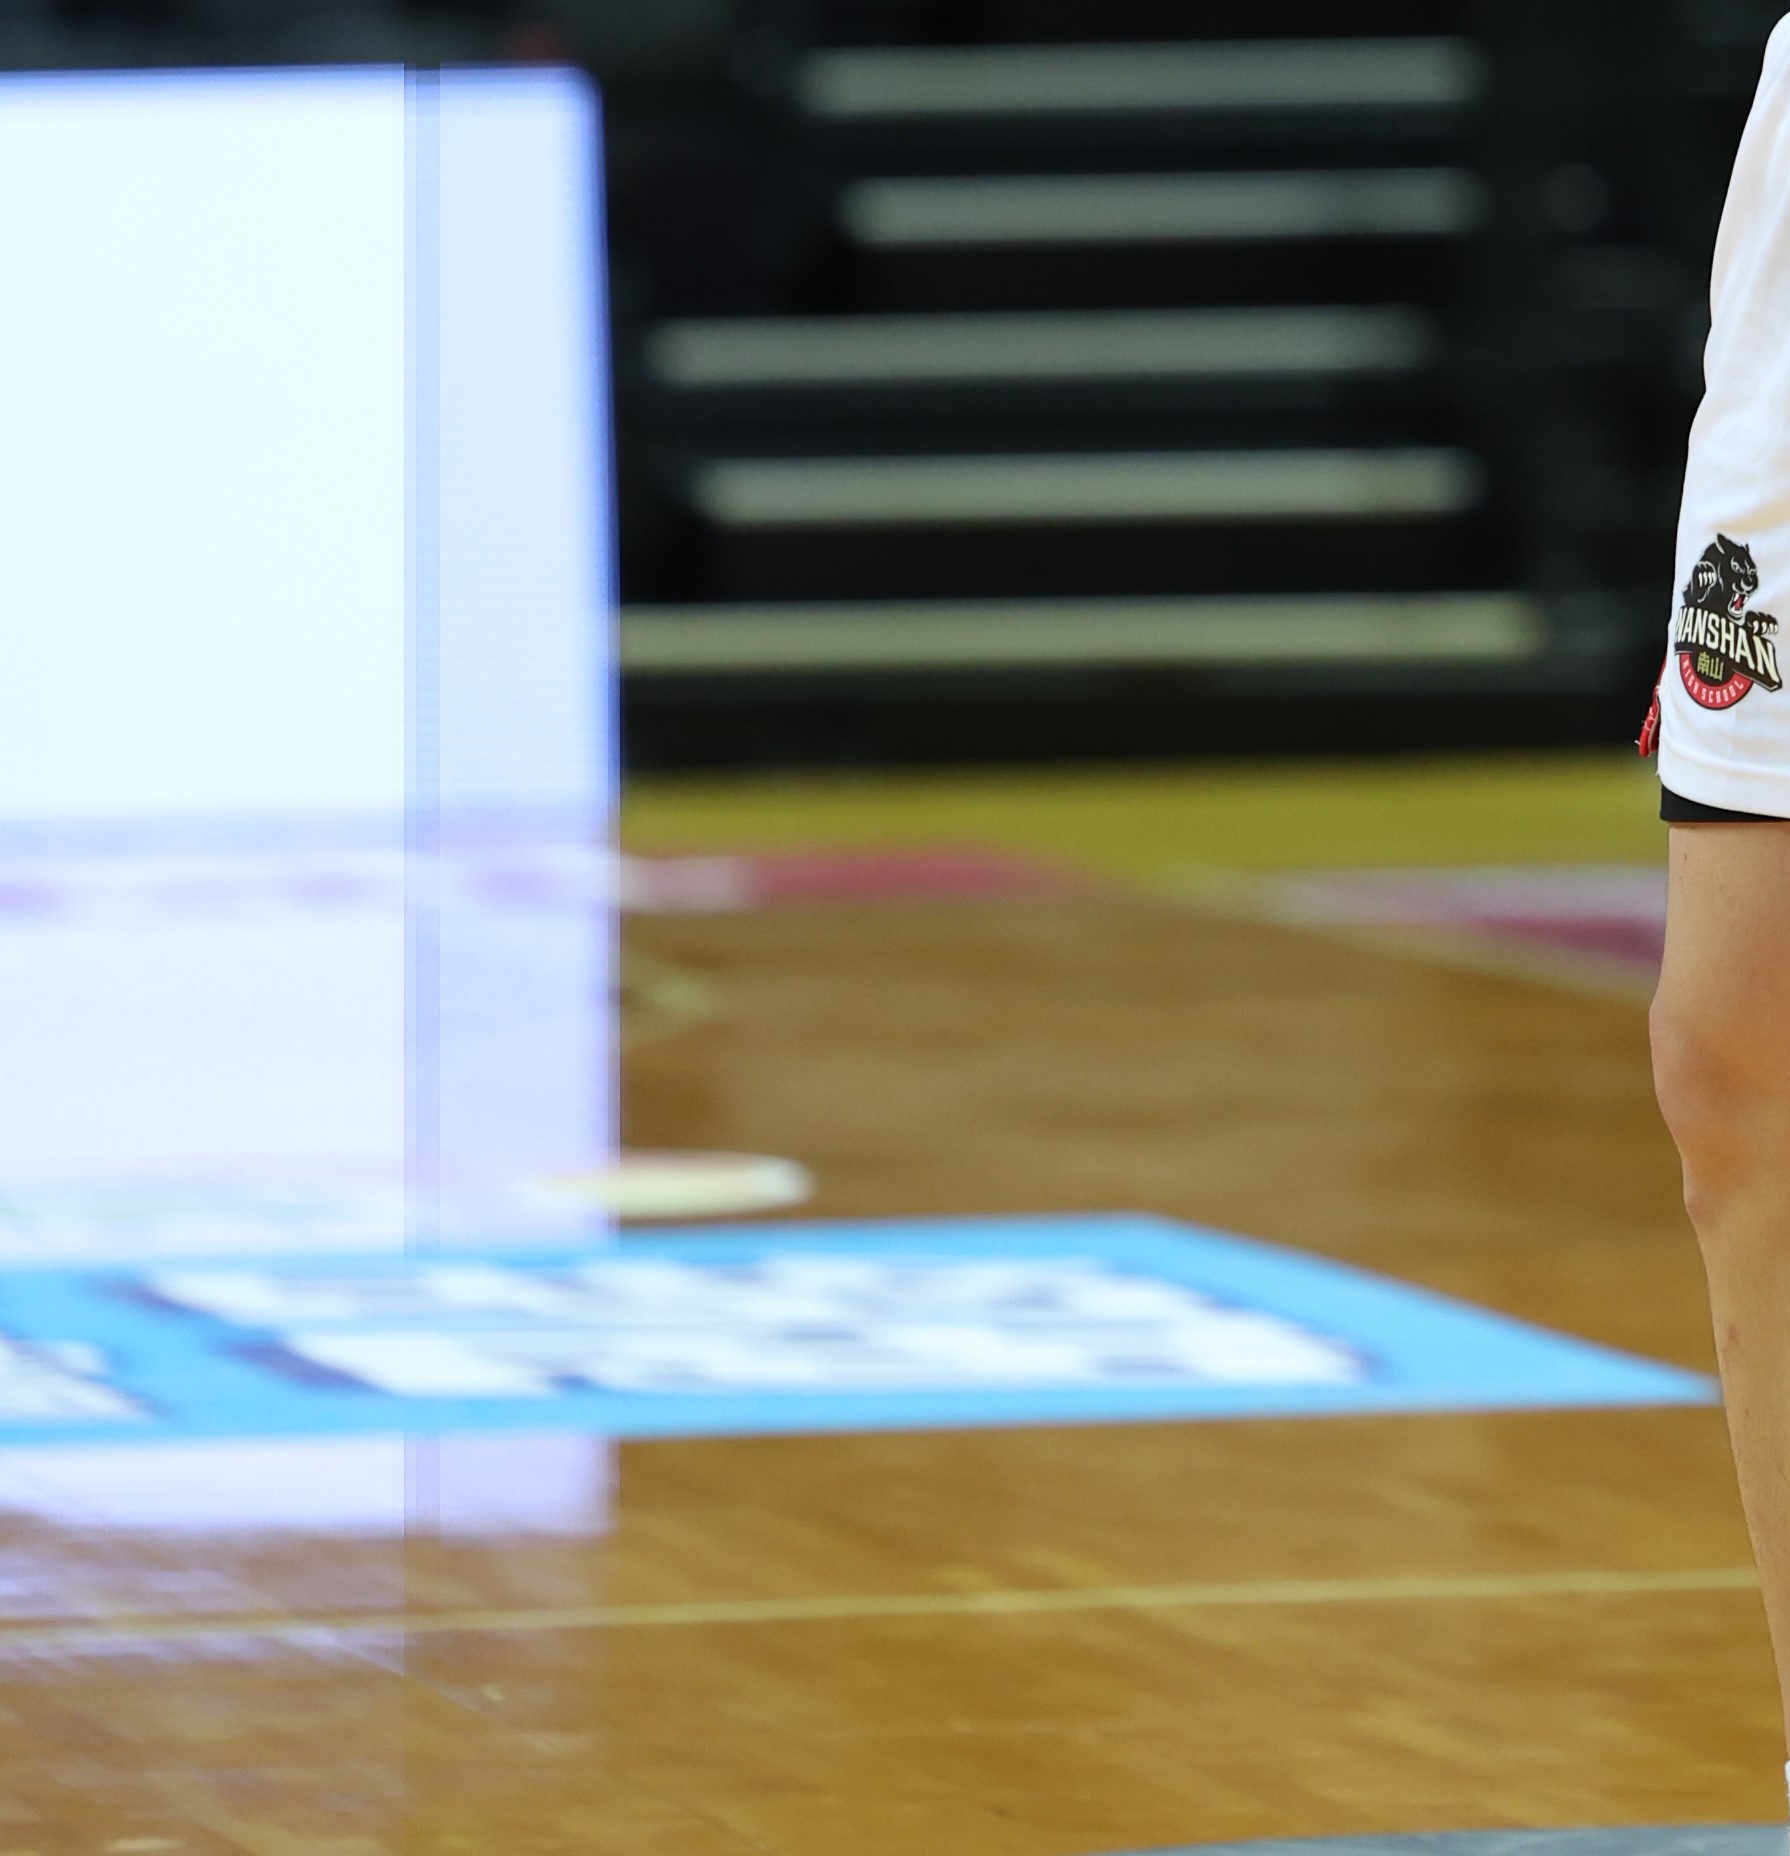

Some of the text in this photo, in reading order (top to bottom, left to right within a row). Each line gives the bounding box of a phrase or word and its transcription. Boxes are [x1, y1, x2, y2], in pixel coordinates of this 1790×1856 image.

[1675, 606, 1779, 682] NANSHAN
[1697, 651, 1725, 682] 南山
[1701, 680, 1745, 704] SCHOOL
